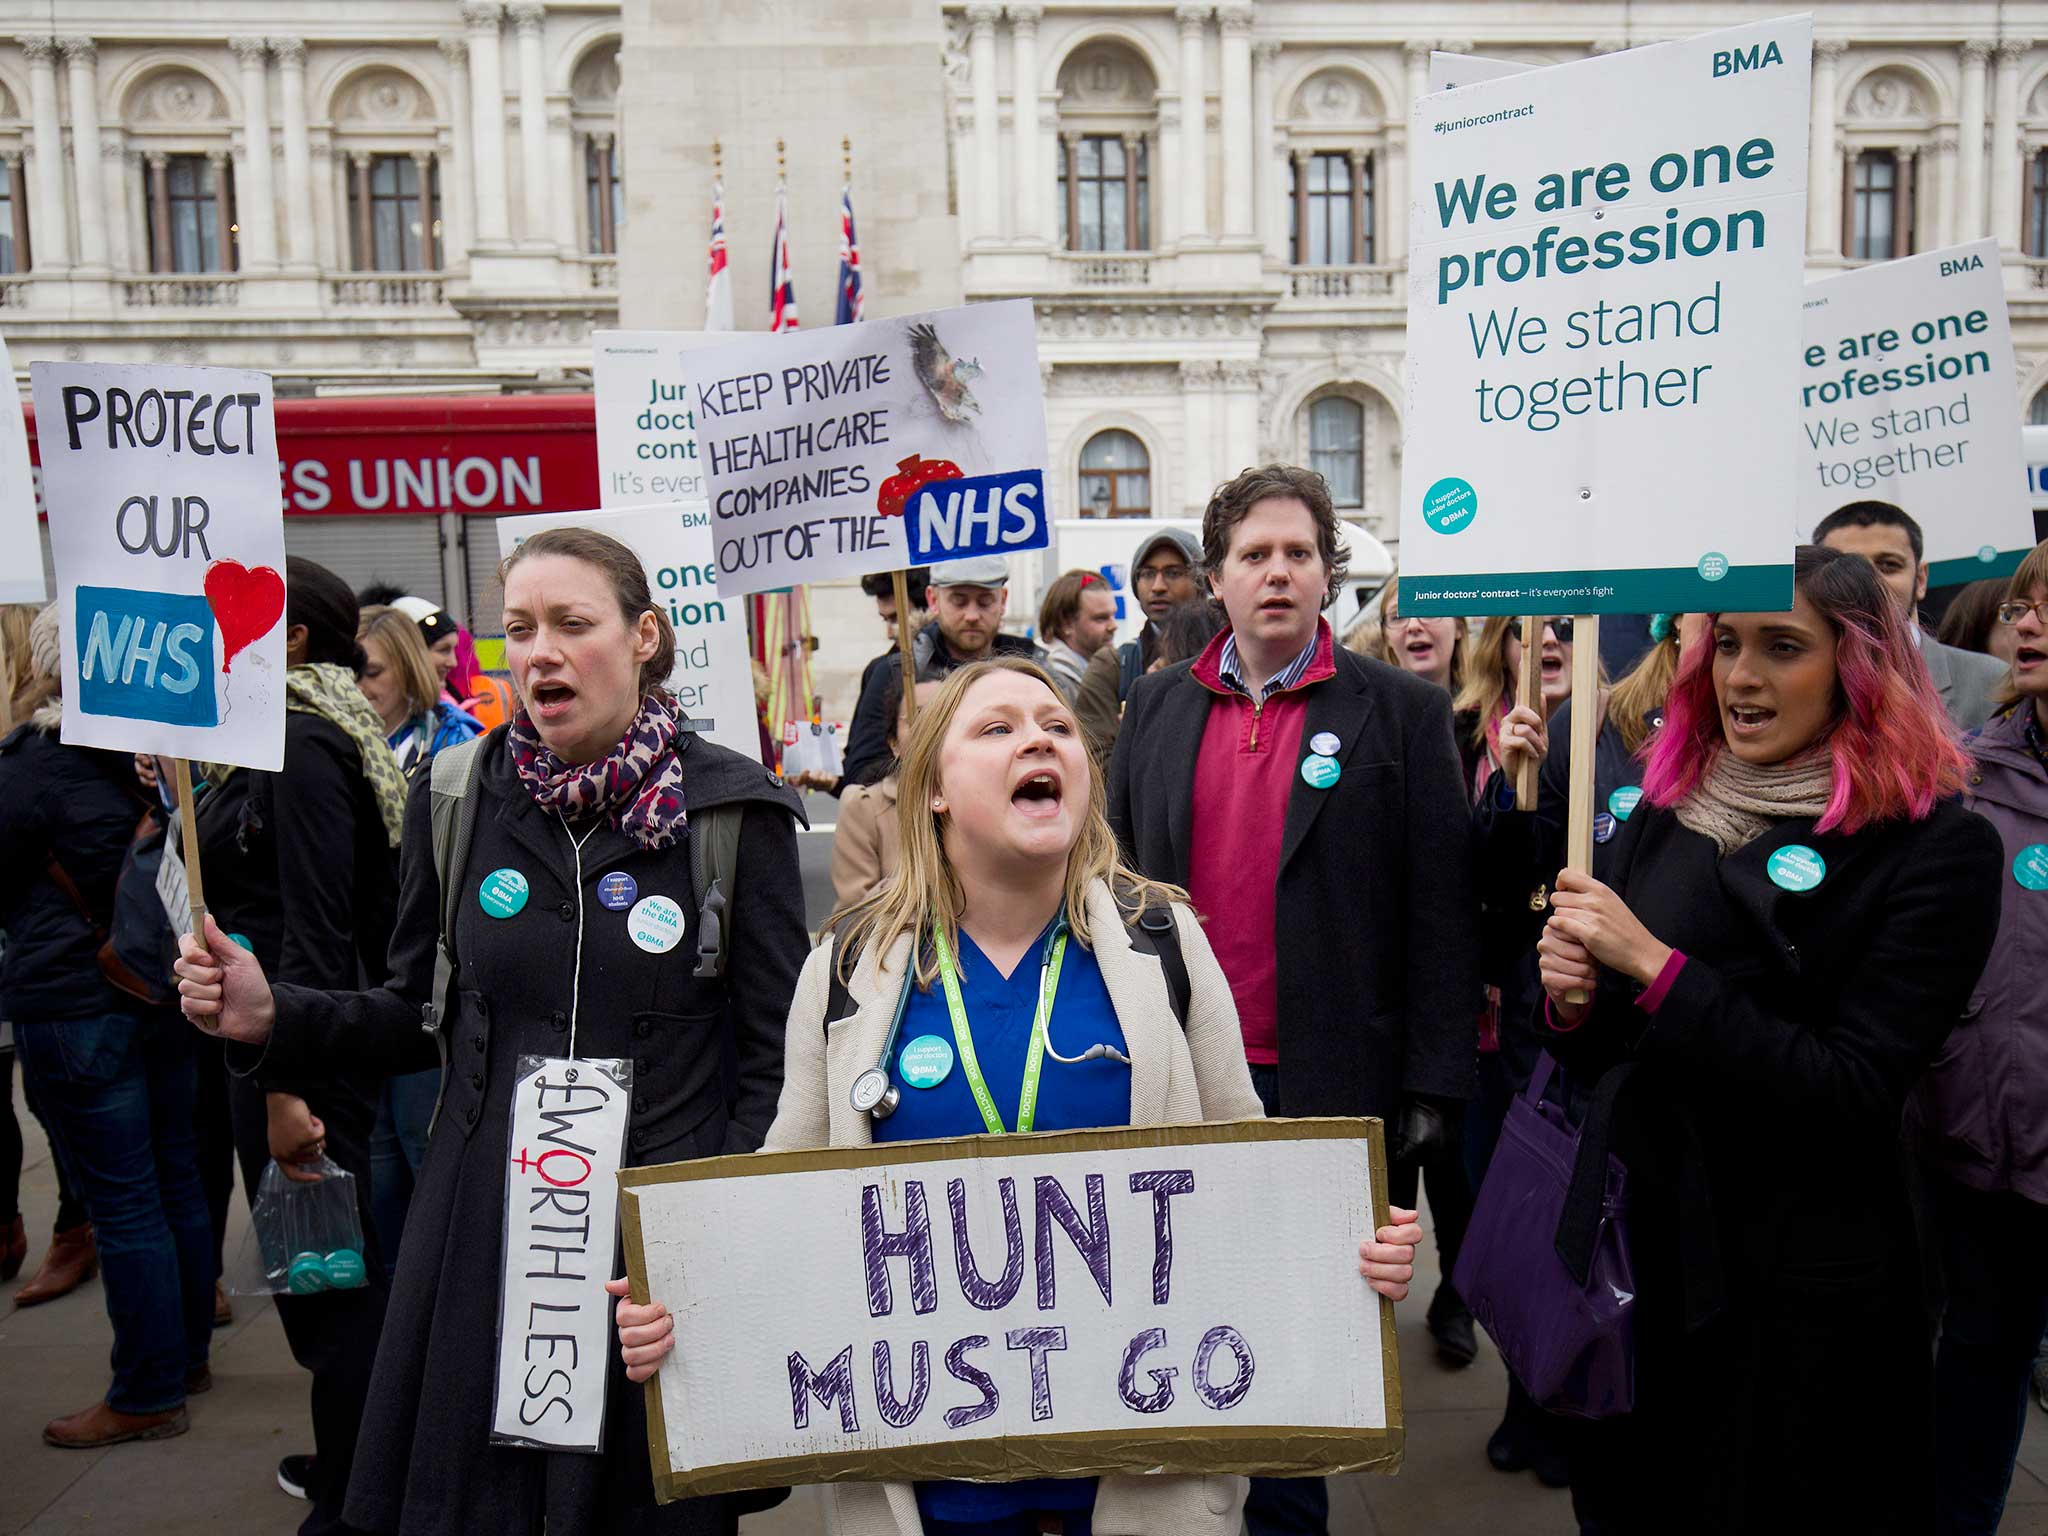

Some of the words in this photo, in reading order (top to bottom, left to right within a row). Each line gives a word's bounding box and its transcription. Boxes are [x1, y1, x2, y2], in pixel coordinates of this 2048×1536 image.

[1712, 40, 1783, 77] BMA
[1434, 104, 1535, 134] #juniorcontract
[1434, 174, 1517, 228] We
[1534, 162, 1630, 213] are
[1649, 137, 1775, 193] one
[1438, 207, 1765, 304] profession
[1939, 254, 1985, 277] BMA
[1468, 306, 1547, 359] We
[1566, 281, 1721, 350] stand
[1804, 345, 1826, 368] e
[1838, 329, 1900, 361] are
[1911, 309, 1988, 345] one
[697, 371, 773, 419] KEEP
[782, 355, 891, 405] PRIVATE
[1475, 360, 1712, 431] together
[1802, 350, 1991, 408] rofession
[62, 386, 260, 455] PROTECT
[637, 408, 695, 430] doct
[1804, 417, 1860, 450] We
[1871, 392, 1970, 440] stand
[637, 439, 697, 459] cont
[1816, 439, 1970, 489] together
[348, 456, 543, 509] UNION
[613, 471, 645, 495] It's
[651, 475, 702, 493] ever
[716, 465, 870, 520] COMPANIES
[116, 495, 211, 561] OUR
[682, 513, 712, 528] BM
[918, 482, 1038, 554] NHS
[1449, 507, 1469, 522] BMA
[720, 529, 783, 574] OUT
[784, 521, 824, 561] OF
[828, 515, 890, 555] THE
[657, 563, 717, 589] one
[1415, 590, 1441, 601] Junior
[1443, 589, 1480, 599] doctors'
[1481, 588, 1519, 598] contract
[1529, 587, 1542, 597] it's
[1543, 586, 1591, 599] everyone's
[1592, 585, 1614, 597] fight
[664, 598, 725, 626] ion
[82, 610, 205, 694] NHS
[498, 890, 513, 904] BMA
[1785, 870, 1803, 883] BMA
[641, 907, 656, 919] the
[657, 914, 677, 928] BMA
[649, 900, 661, 912] We
[662, 908, 677, 918] are
[646, 934, 664, 949] BMA
[945, 969, 958, 1002] DOCTOR
[953, 1007, 967, 1040] DOCTOR
[963, 1046, 978, 1081] DOCTOR
[976, 1086, 997, 1124] DOCTOR
[1022, 1079, 1034, 1117] DOCTOR
[1028, 1037, 1041, 1072] DOCTOR
[1044, 960, 1057, 992] DOCTOR
[920, 1065, 938, 1074] BMA
[861, 1169, 1195, 1317] HUNT
[787, 1325, 1066, 1433] MUST
[1118, 1324, 1256, 1414] GO
